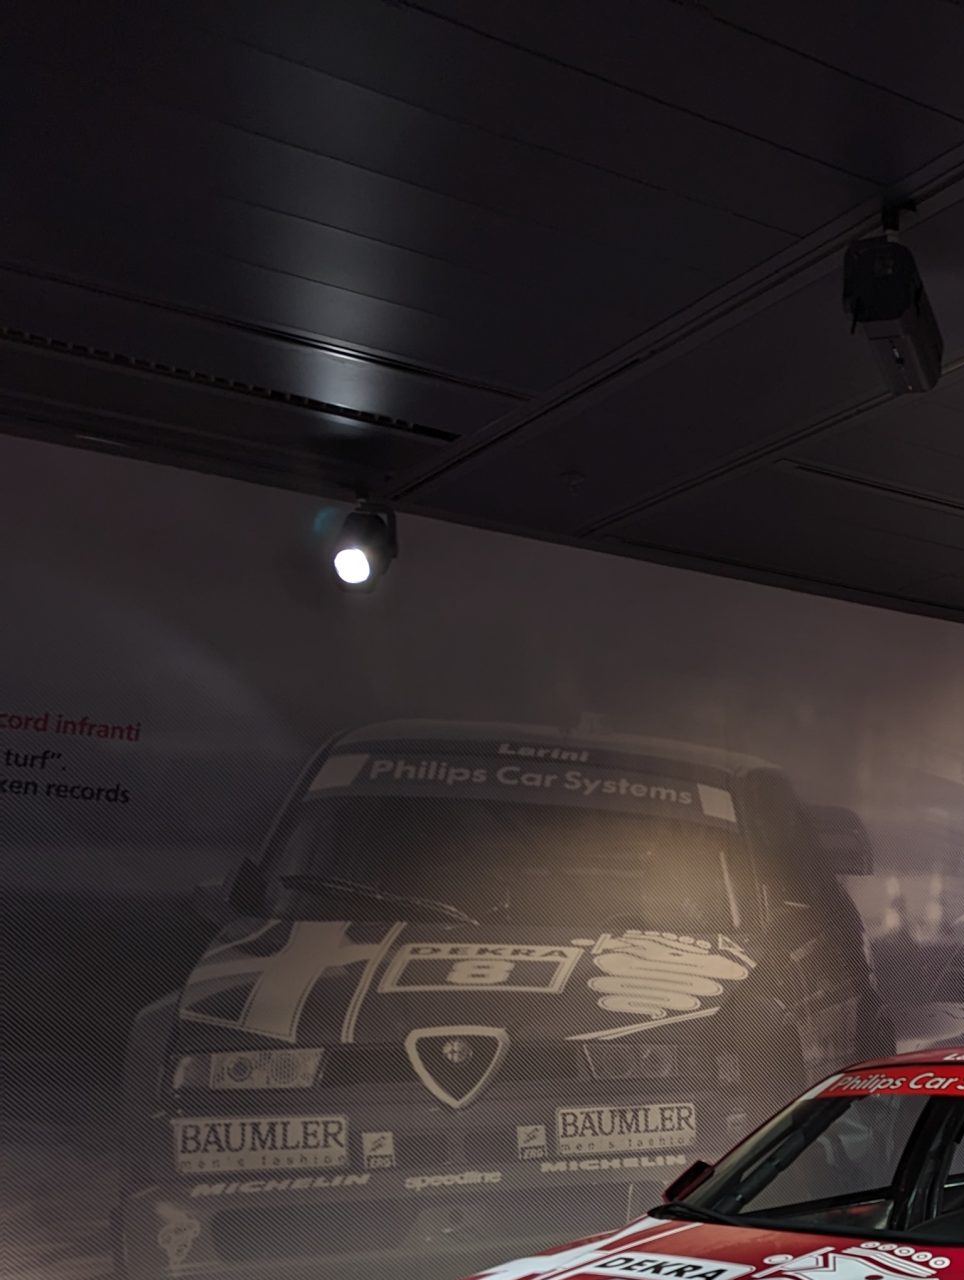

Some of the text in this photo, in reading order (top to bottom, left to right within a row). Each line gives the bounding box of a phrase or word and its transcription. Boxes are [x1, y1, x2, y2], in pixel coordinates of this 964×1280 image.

[56, 714, 142, 741] infranti
[499, 743, 590, 762] Larini
[370, 759, 693, 804] Philips Car Systems
[46, 783, 130, 803] records
[409, 946, 570, 960] DEKRA
[444, 959, 516, 985] 8
[830, 1073, 907, 1092] Philips
[908, 1072, 959, 1090] Car
[540, 1154, 687, 1172] MICHELIN
